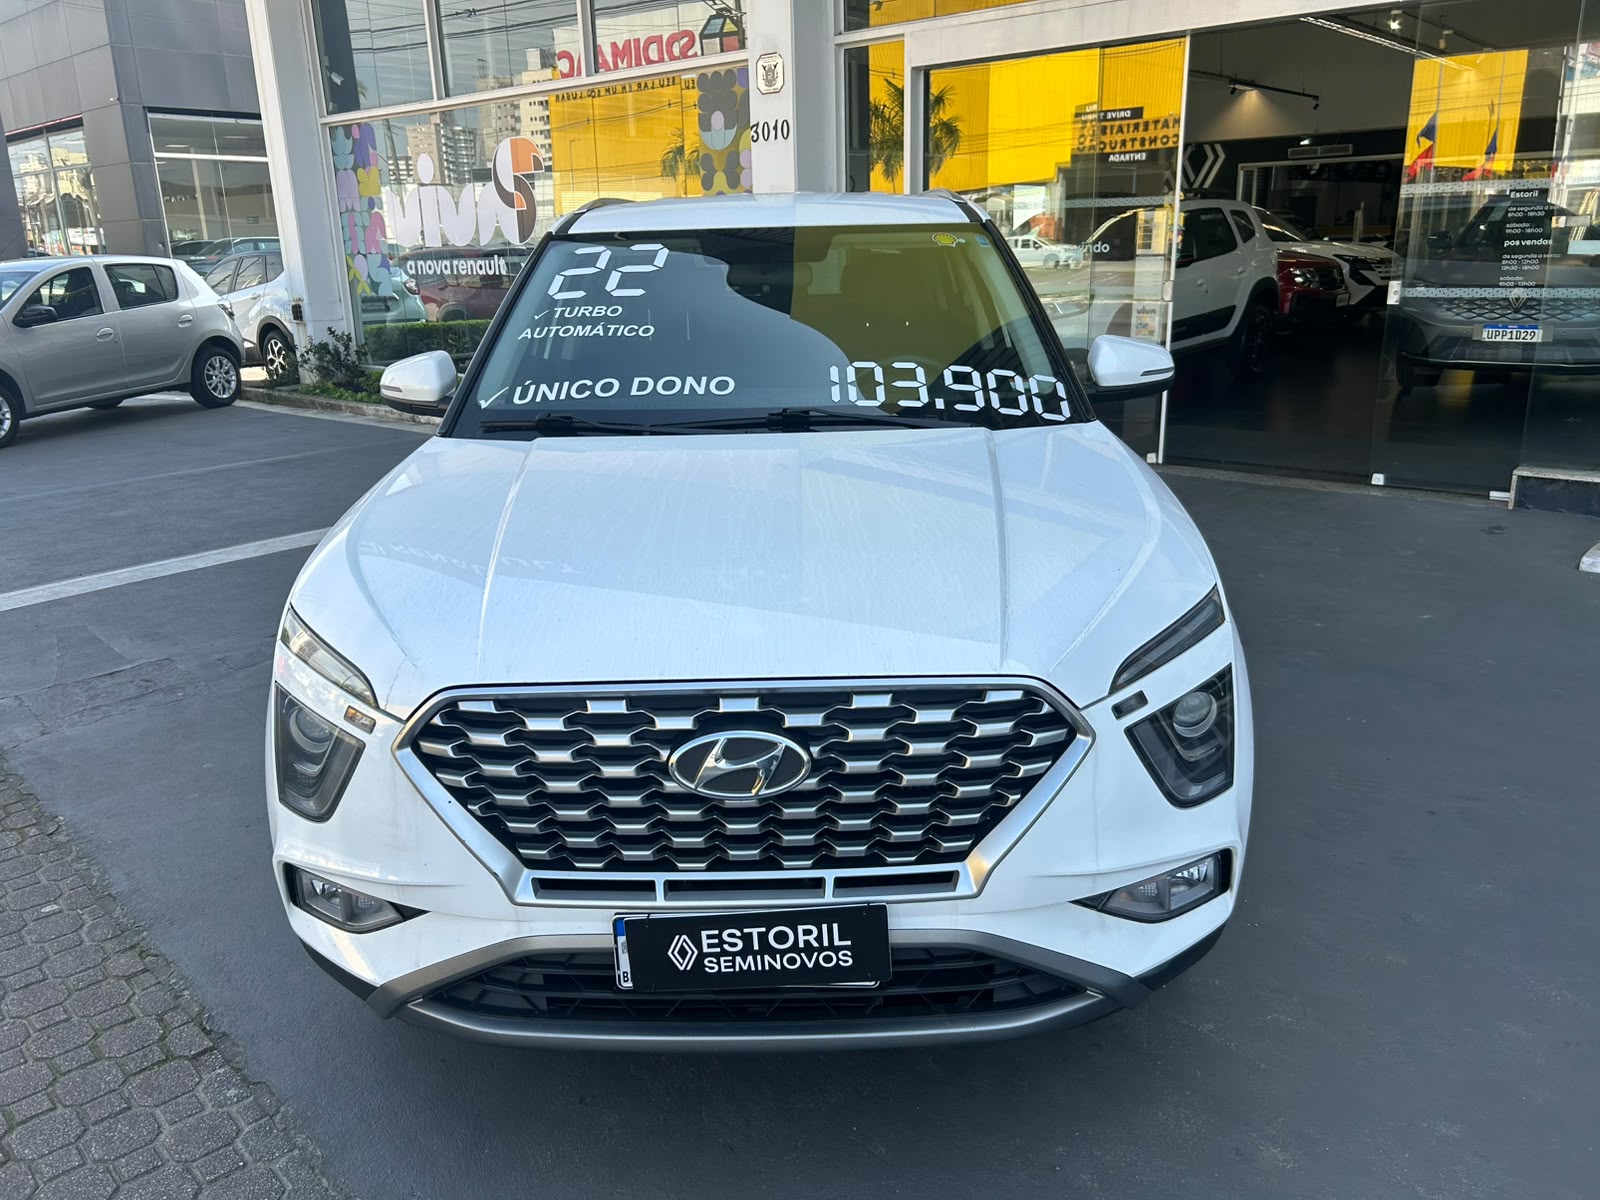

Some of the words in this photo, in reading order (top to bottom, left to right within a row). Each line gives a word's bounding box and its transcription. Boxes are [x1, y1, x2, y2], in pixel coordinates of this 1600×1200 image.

[750, 119, 790, 143] 3010
[1510, 190, 1539, 199] Estoril
[1521, 238, 1552, 246] vendas
[407, 259, 416, 275] a
[417, 258, 450, 275] nova
[452, 255, 507, 275] renault
[548, 243, 670, 300] 22
[553, 305, 623, 319] TURBO
[517, 321, 655, 340] AUTOMÁTICO
[1486, 330, 1536, 341] UPP1D29
[512, 377, 620, 405] ÚNICO
[630, 376, 736, 396] DONO
[829, 361, 1071, 422] 103.900
[700, 923, 852, 953] ESTORIL
[703, 950, 853, 973] SEMINOVOS
